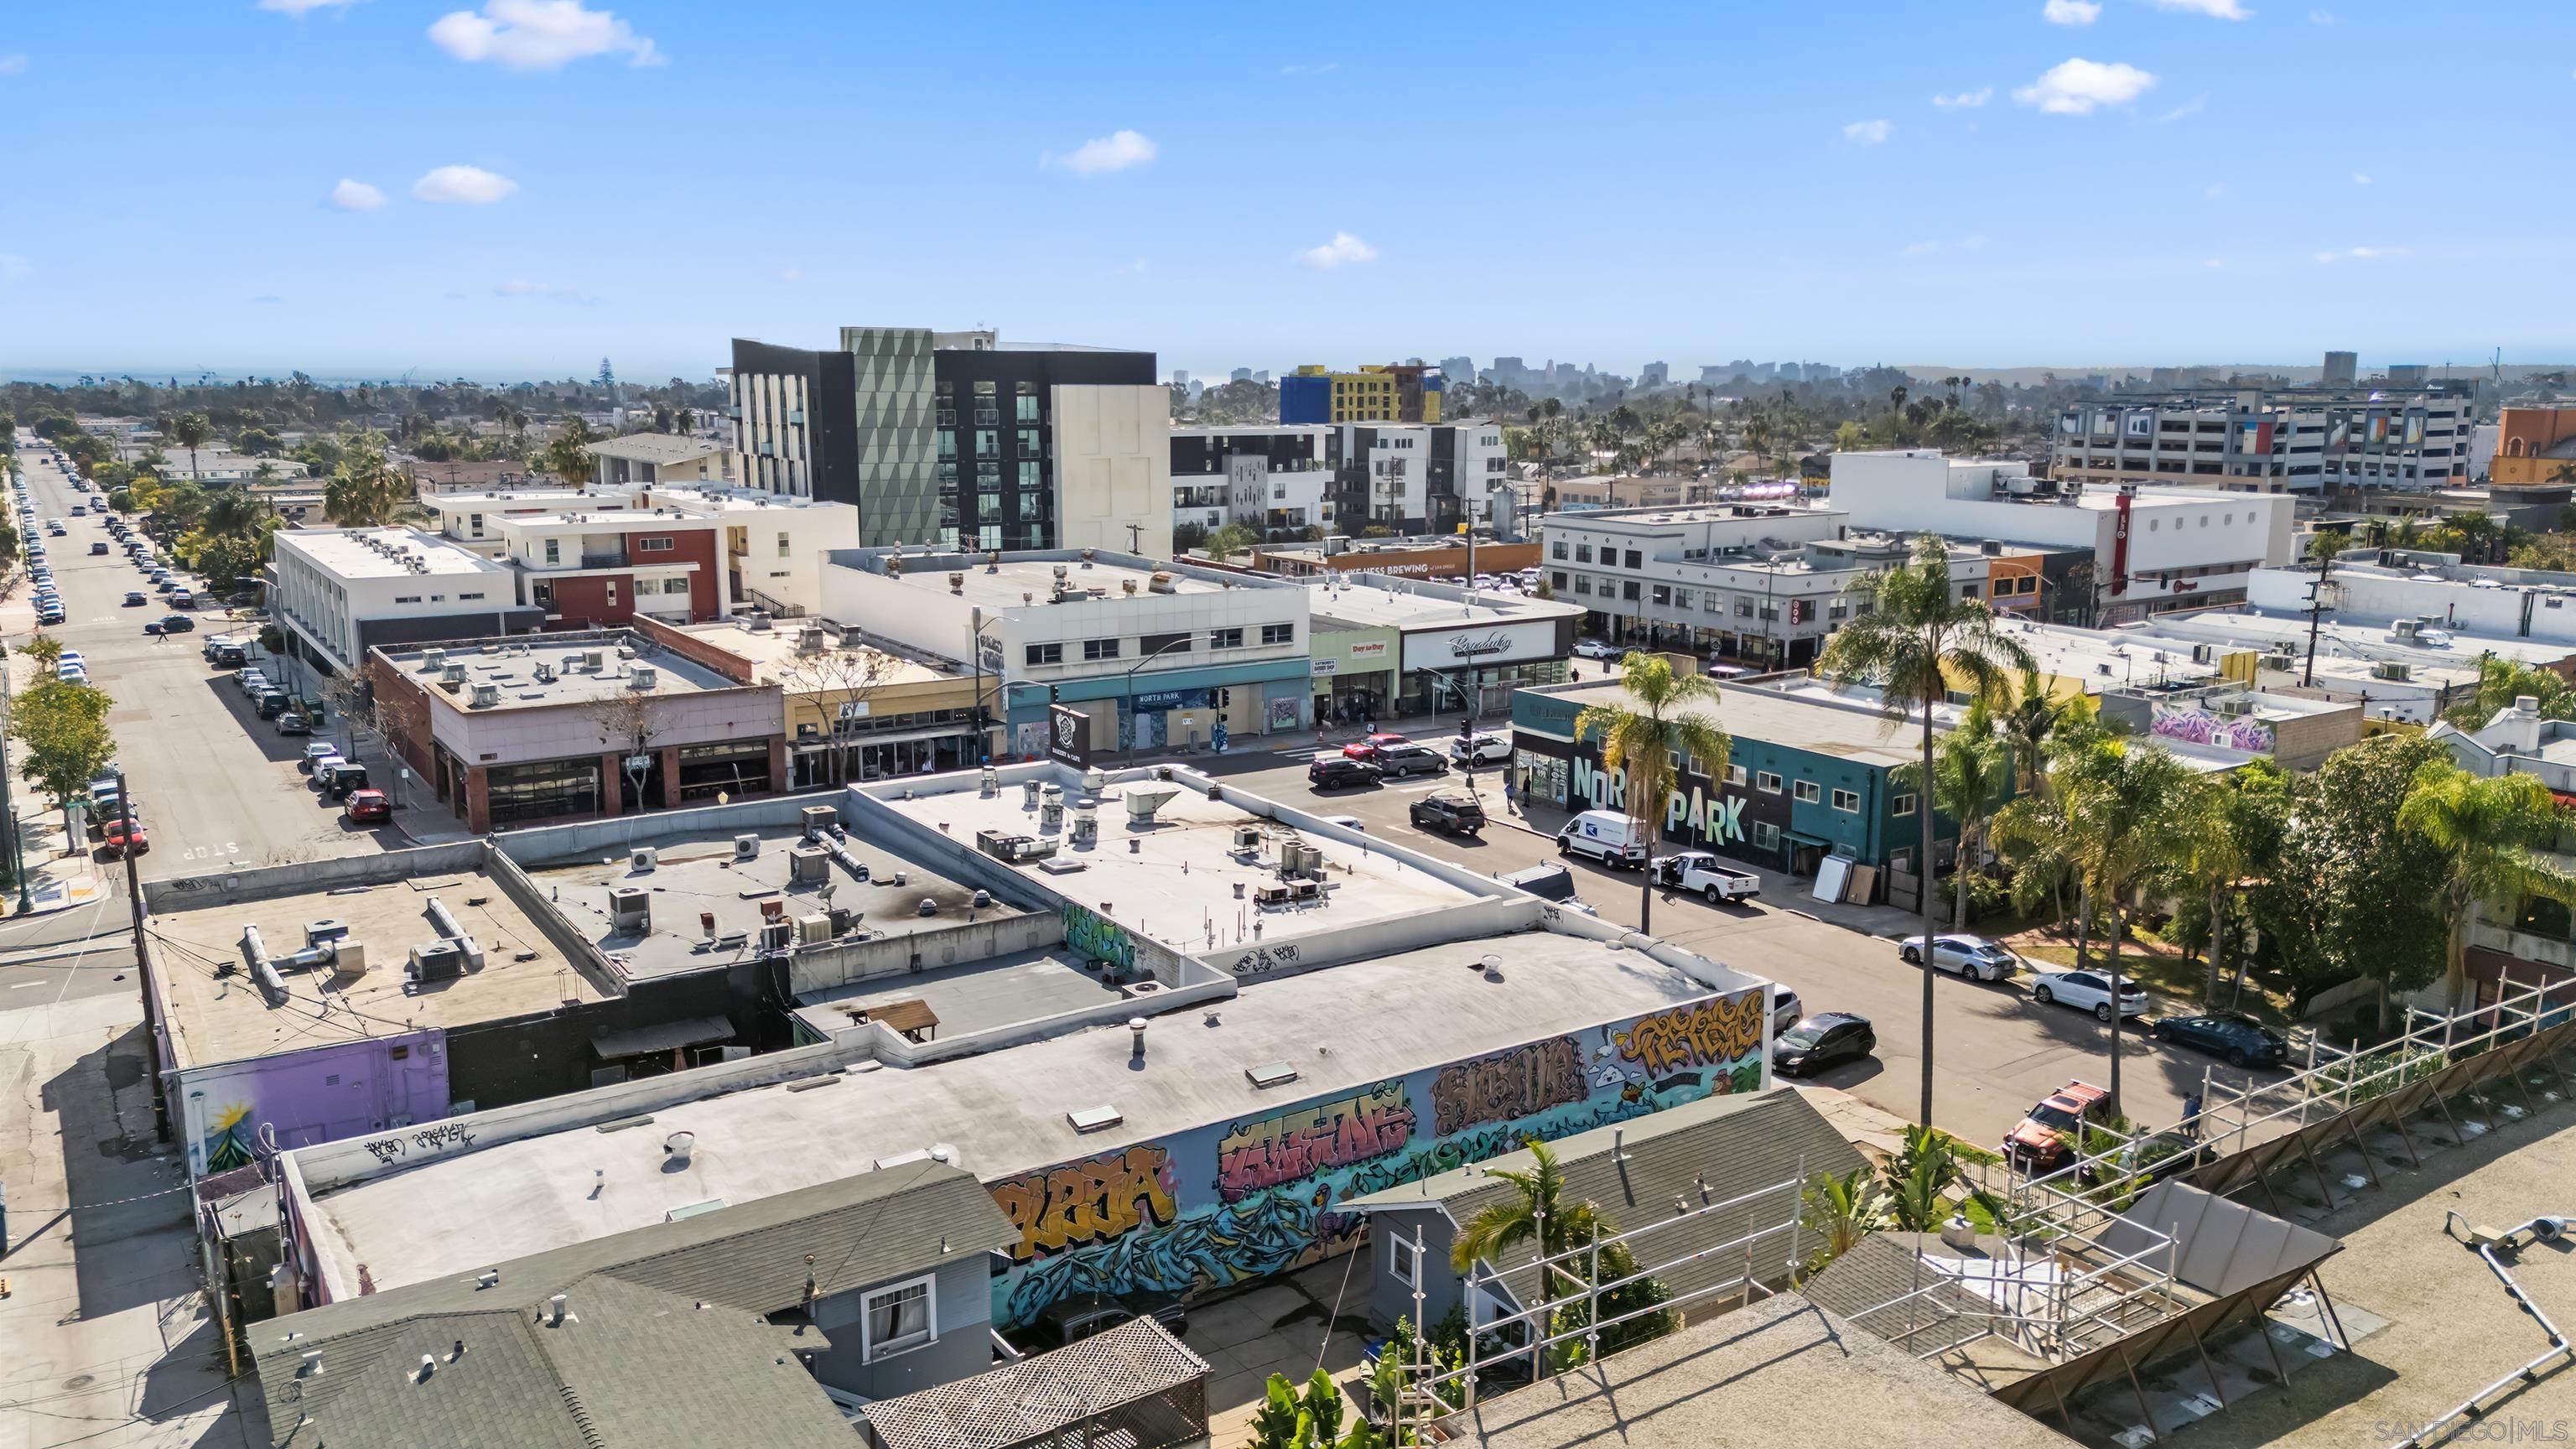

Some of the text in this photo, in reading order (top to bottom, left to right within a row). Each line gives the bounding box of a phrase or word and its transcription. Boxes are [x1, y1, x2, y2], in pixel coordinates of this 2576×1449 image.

[1387, 564, 1428, 574] BREWING
[1353, 645, 1366, 653] Day
[1372, 643, 1385, 652] Day
[1140, 692, 1180, 703] NORTH PARK
[1667, 786, 1748, 847] PARK
[183, 842, 240, 860] STOP
